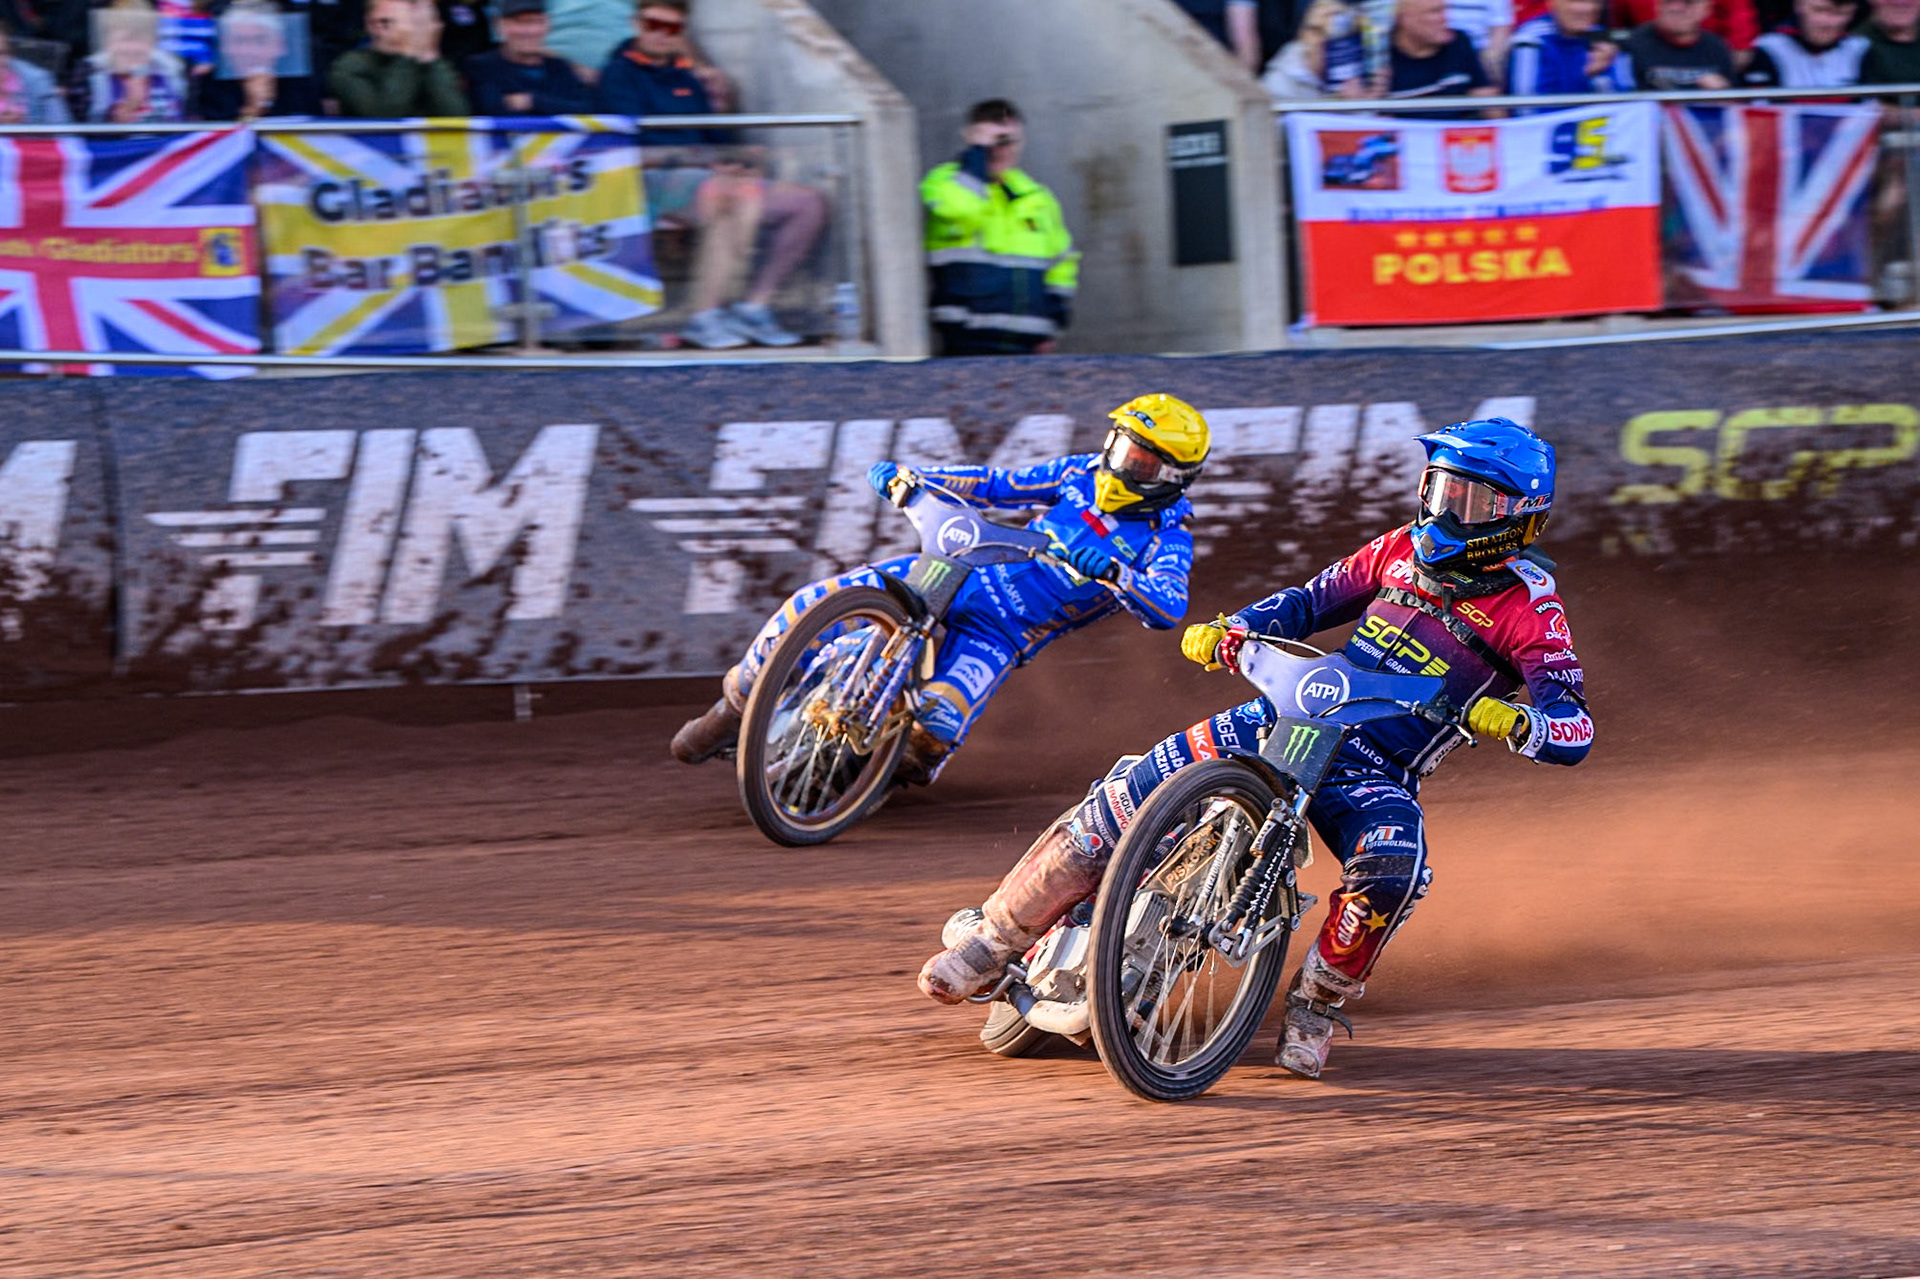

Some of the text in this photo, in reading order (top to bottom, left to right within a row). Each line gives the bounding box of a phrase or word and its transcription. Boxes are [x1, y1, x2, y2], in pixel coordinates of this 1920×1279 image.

[303, 246, 393, 290] Bar
[1373, 248, 1572, 286] POLSKA
[180, 424, 600, 632] FIM
[944, 527, 973, 546] ATPI
[1466, 525, 1525, 550] STRATTON
[1466, 541, 1519, 562] BROKERS
[1456, 601, 1495, 629] SGP
[1355, 638, 1385, 661] SPEEDWA
[1357, 614, 1432, 664] SGP
[1302, 682, 1341, 702] ATPI
[1348, 735, 1385, 765] Auto
[1362, 825, 1404, 847] MT
